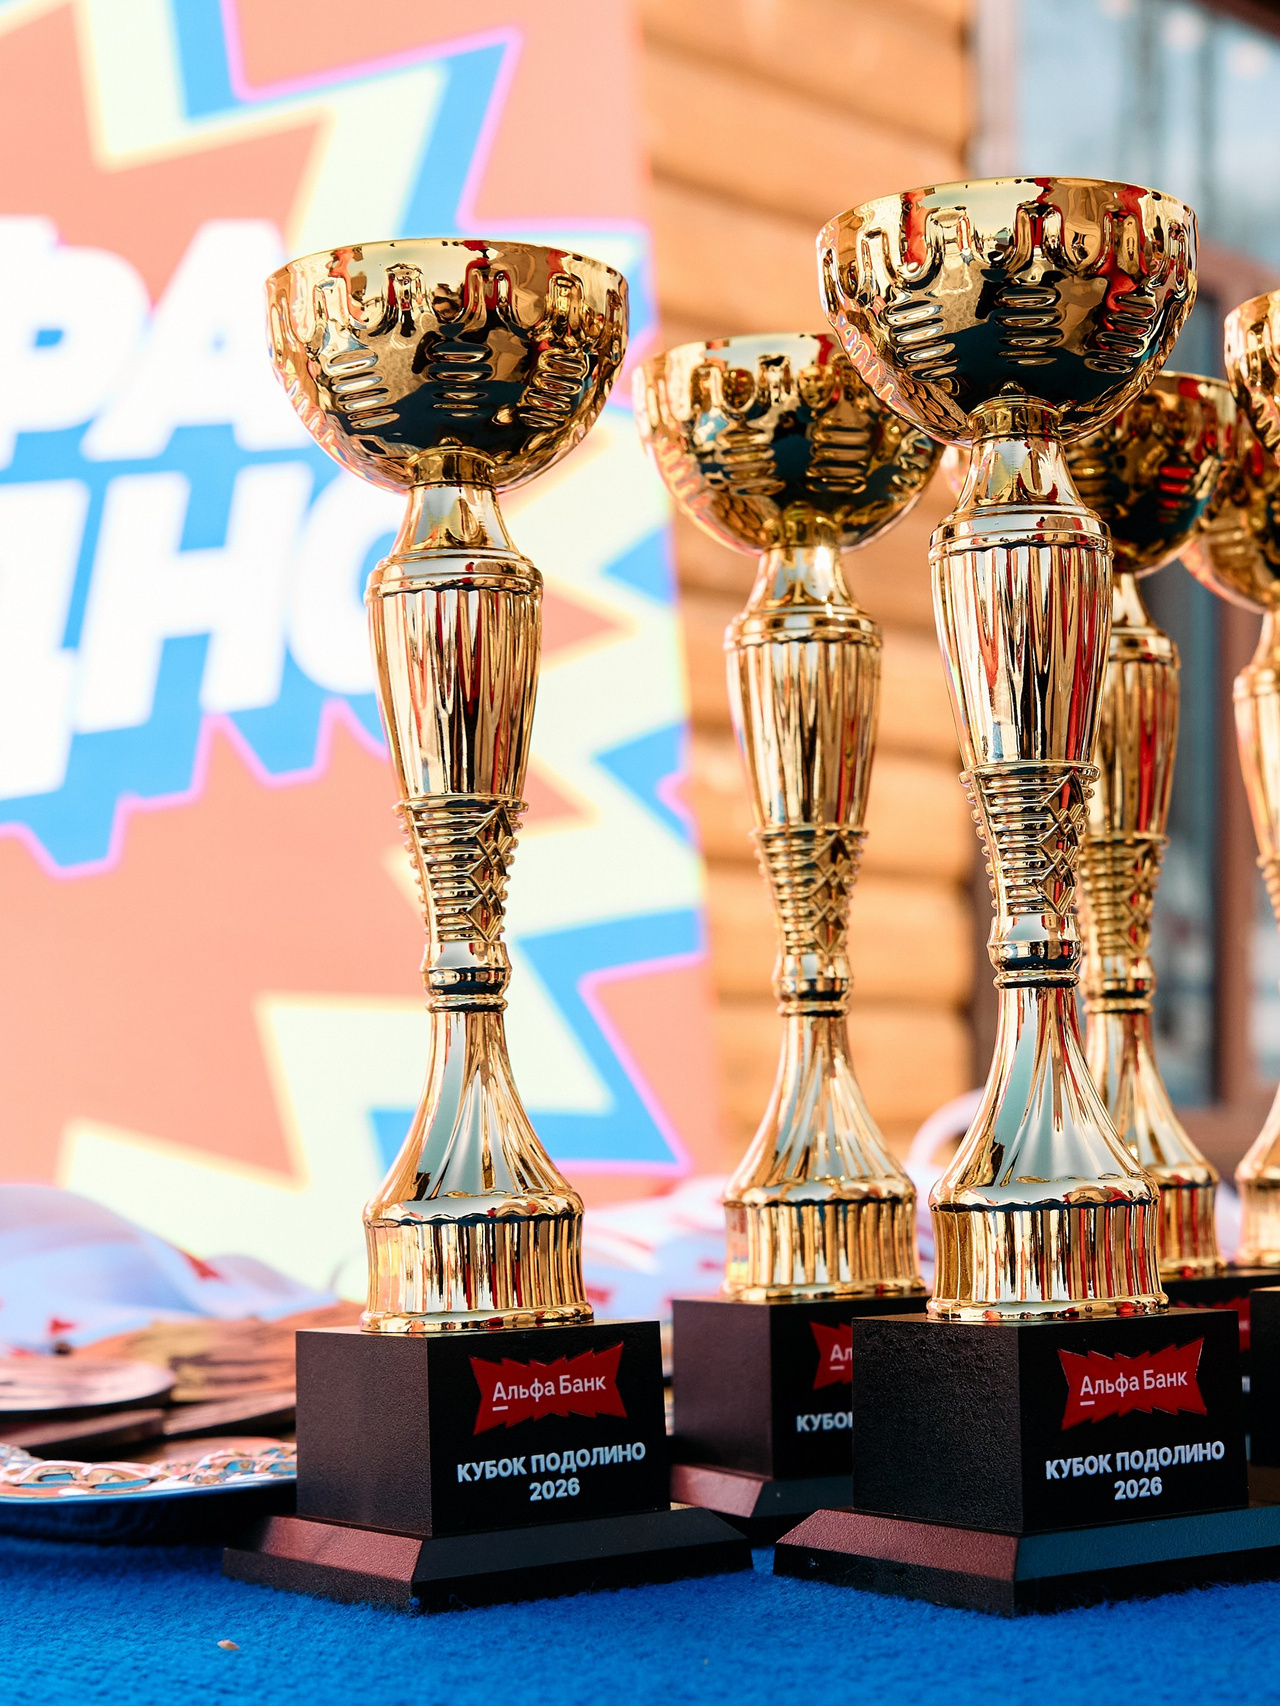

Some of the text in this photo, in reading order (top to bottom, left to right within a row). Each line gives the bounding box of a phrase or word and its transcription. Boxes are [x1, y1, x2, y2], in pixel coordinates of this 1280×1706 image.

[492, 1374, 607, 1411] Альфа Банк
[1080, 1369, 1188, 1406] Альфа Банк
[457, 1442, 646, 1483] КУБОК ПОДОЛИНО
[1045, 1440, 1225, 1480] КУБОК ПОДОЛИНО
[529, 1477, 580, 1502] 2026
[1113, 1476, 1163, 1501] 2026
